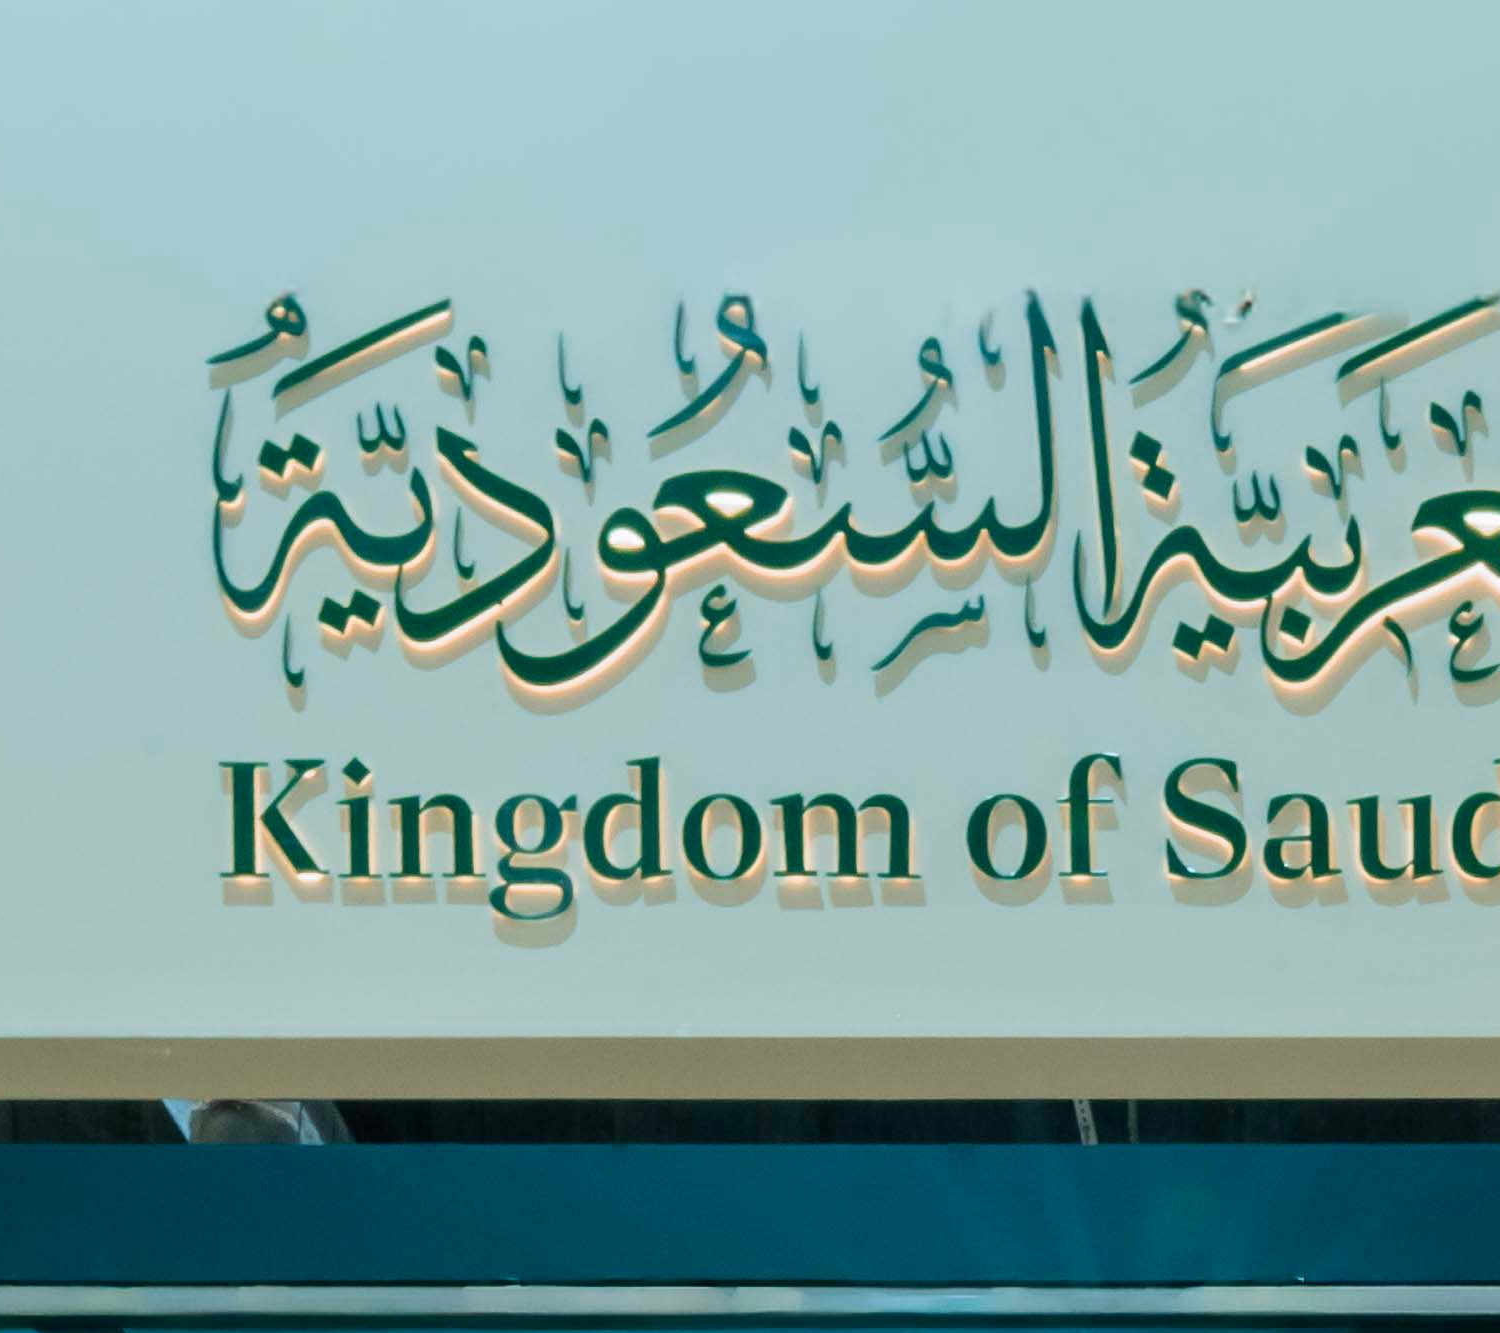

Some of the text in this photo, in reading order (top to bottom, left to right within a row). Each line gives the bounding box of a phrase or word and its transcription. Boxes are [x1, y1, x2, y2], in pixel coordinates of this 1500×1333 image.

[208, 290, 1122, 690] السعودية
[218, 755, 923, 920] Kingdom
[966, 753, 1124, 880] of
